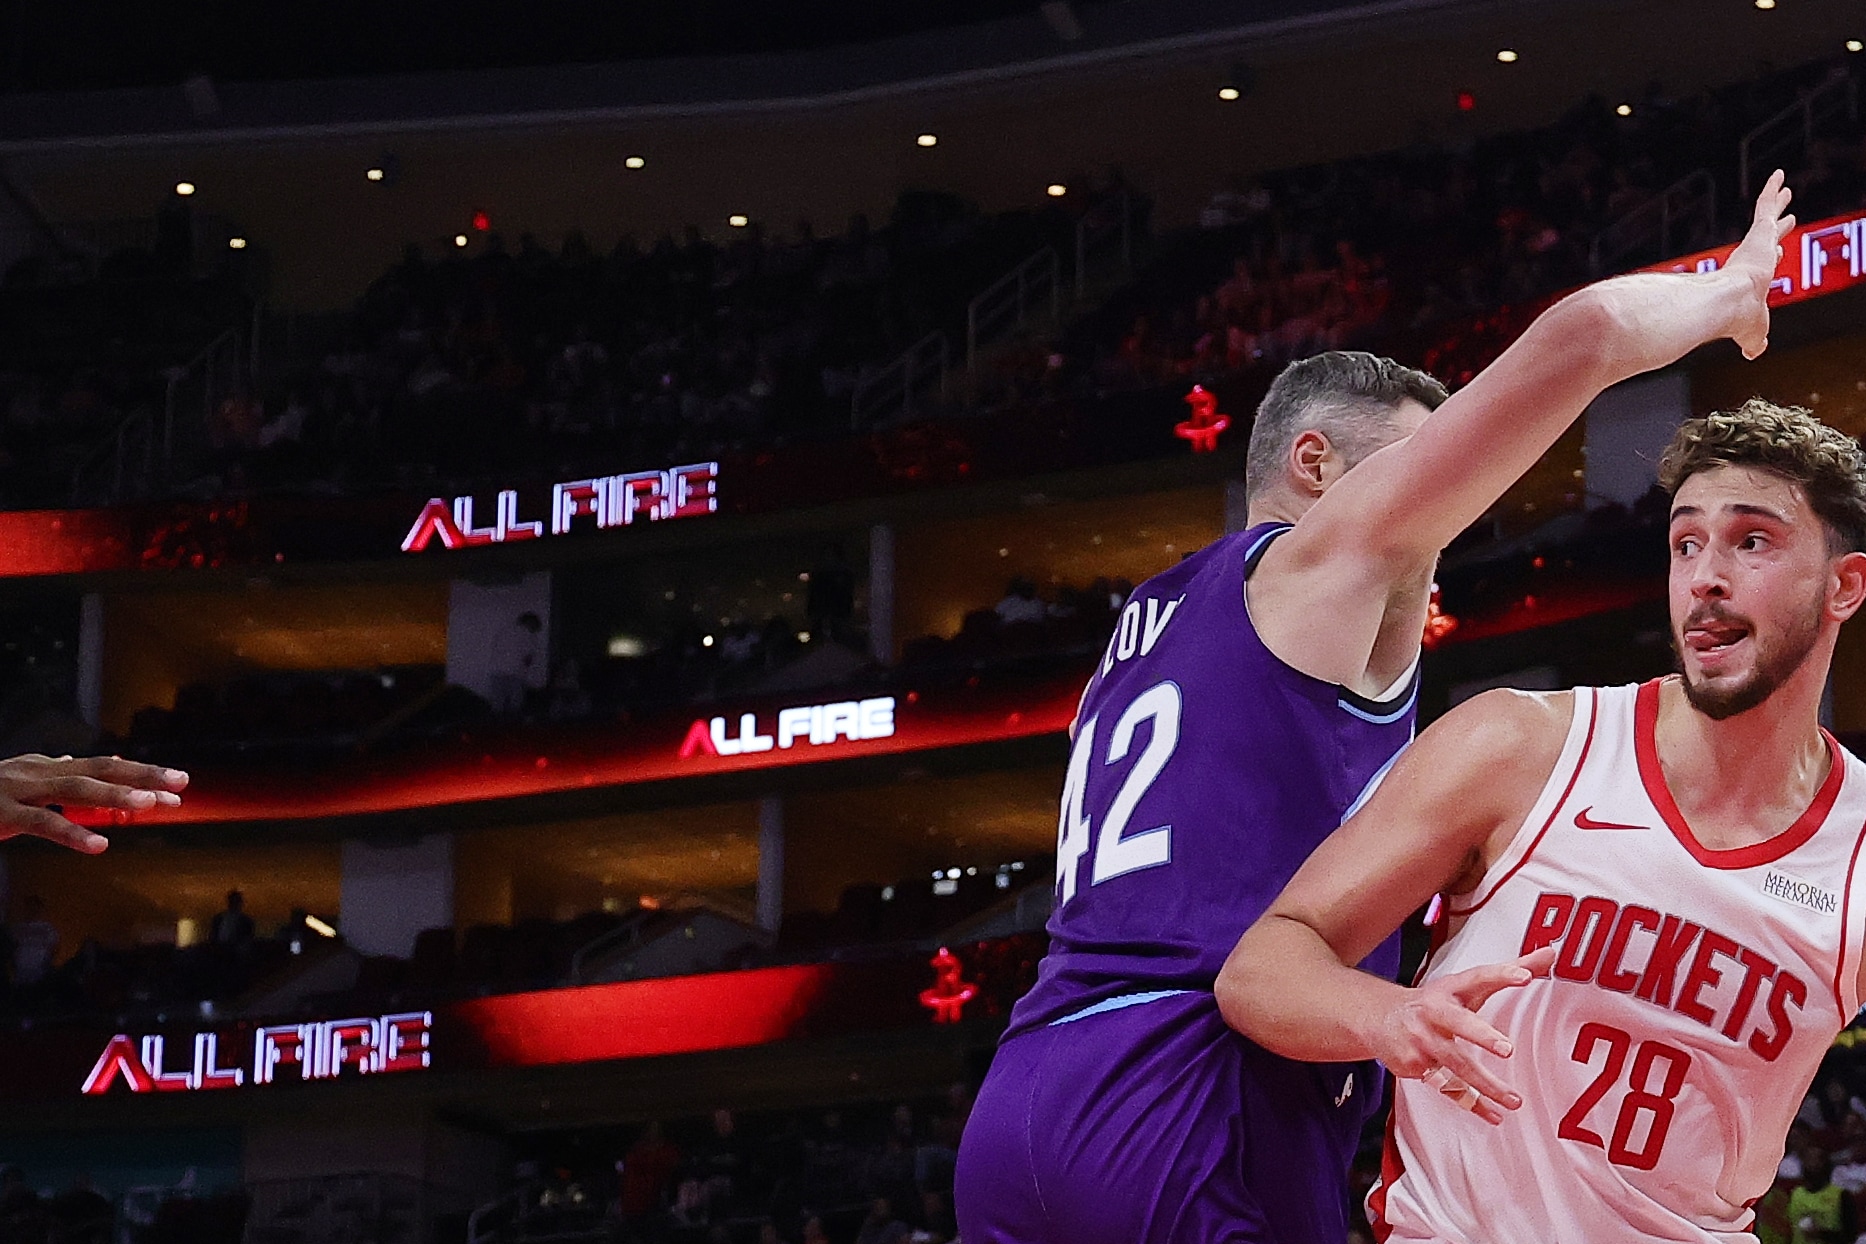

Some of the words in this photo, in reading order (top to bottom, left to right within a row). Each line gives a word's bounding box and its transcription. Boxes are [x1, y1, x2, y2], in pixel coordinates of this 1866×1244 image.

[401, 488, 543, 552] ALL
[552, 462, 718, 535] FIRE
[1102, 592, 1187, 679] LOV
[678, 711, 774, 759] ALL
[779, 697, 895, 750] FIRE
[1055, 680, 1183, 907] 42
[1764, 879, 1837, 913] HERMANN
[1765, 871, 1838, 905] MEMORIAL
[1519, 892, 1808, 1062] ROCKETS
[82, 1033, 243, 1094] ALL
[255, 1011, 432, 1084] FIRE
[1557, 1022, 1692, 1171] 28
